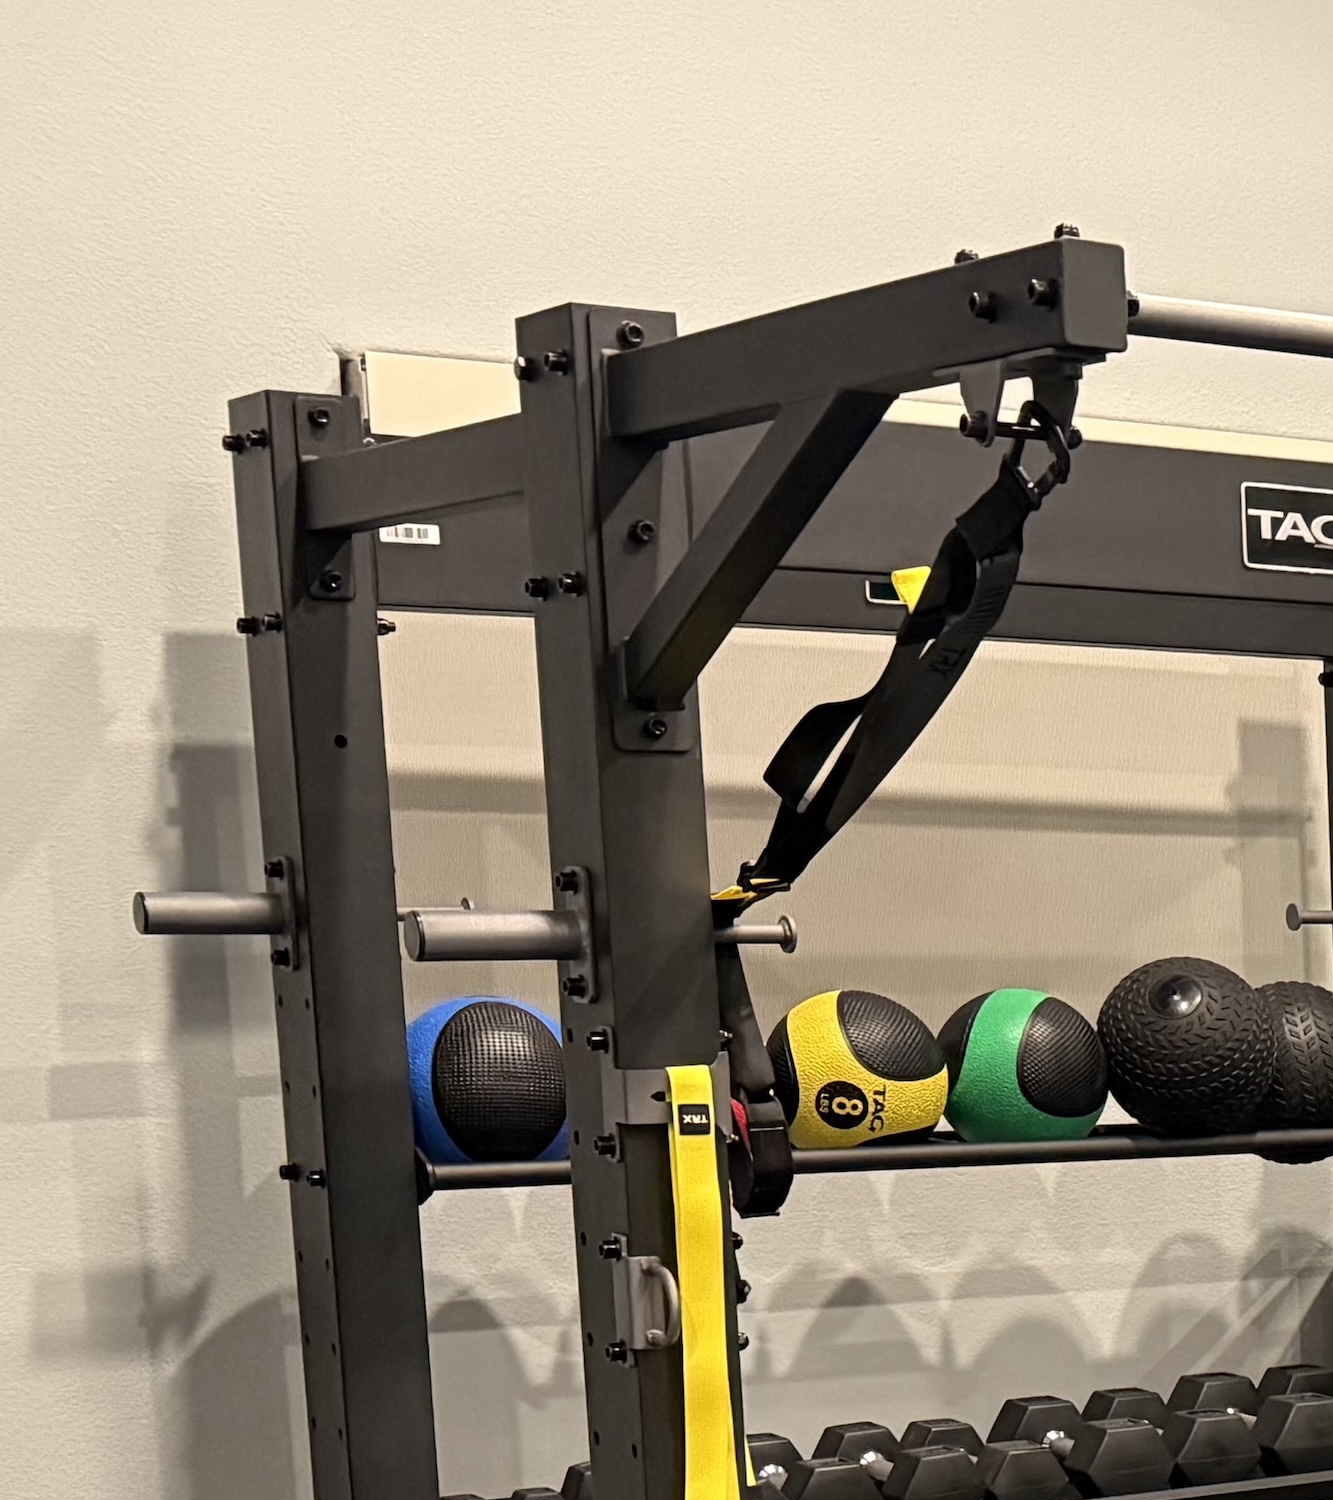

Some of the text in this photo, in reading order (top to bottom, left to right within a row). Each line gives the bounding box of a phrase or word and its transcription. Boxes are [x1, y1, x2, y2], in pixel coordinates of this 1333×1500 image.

[819, 1093, 830, 1114] LBS
[831, 1096, 863, 1116] 8
[868, 1084, 886, 1133] TAG
[682, 1114, 708, 1124] TRX
